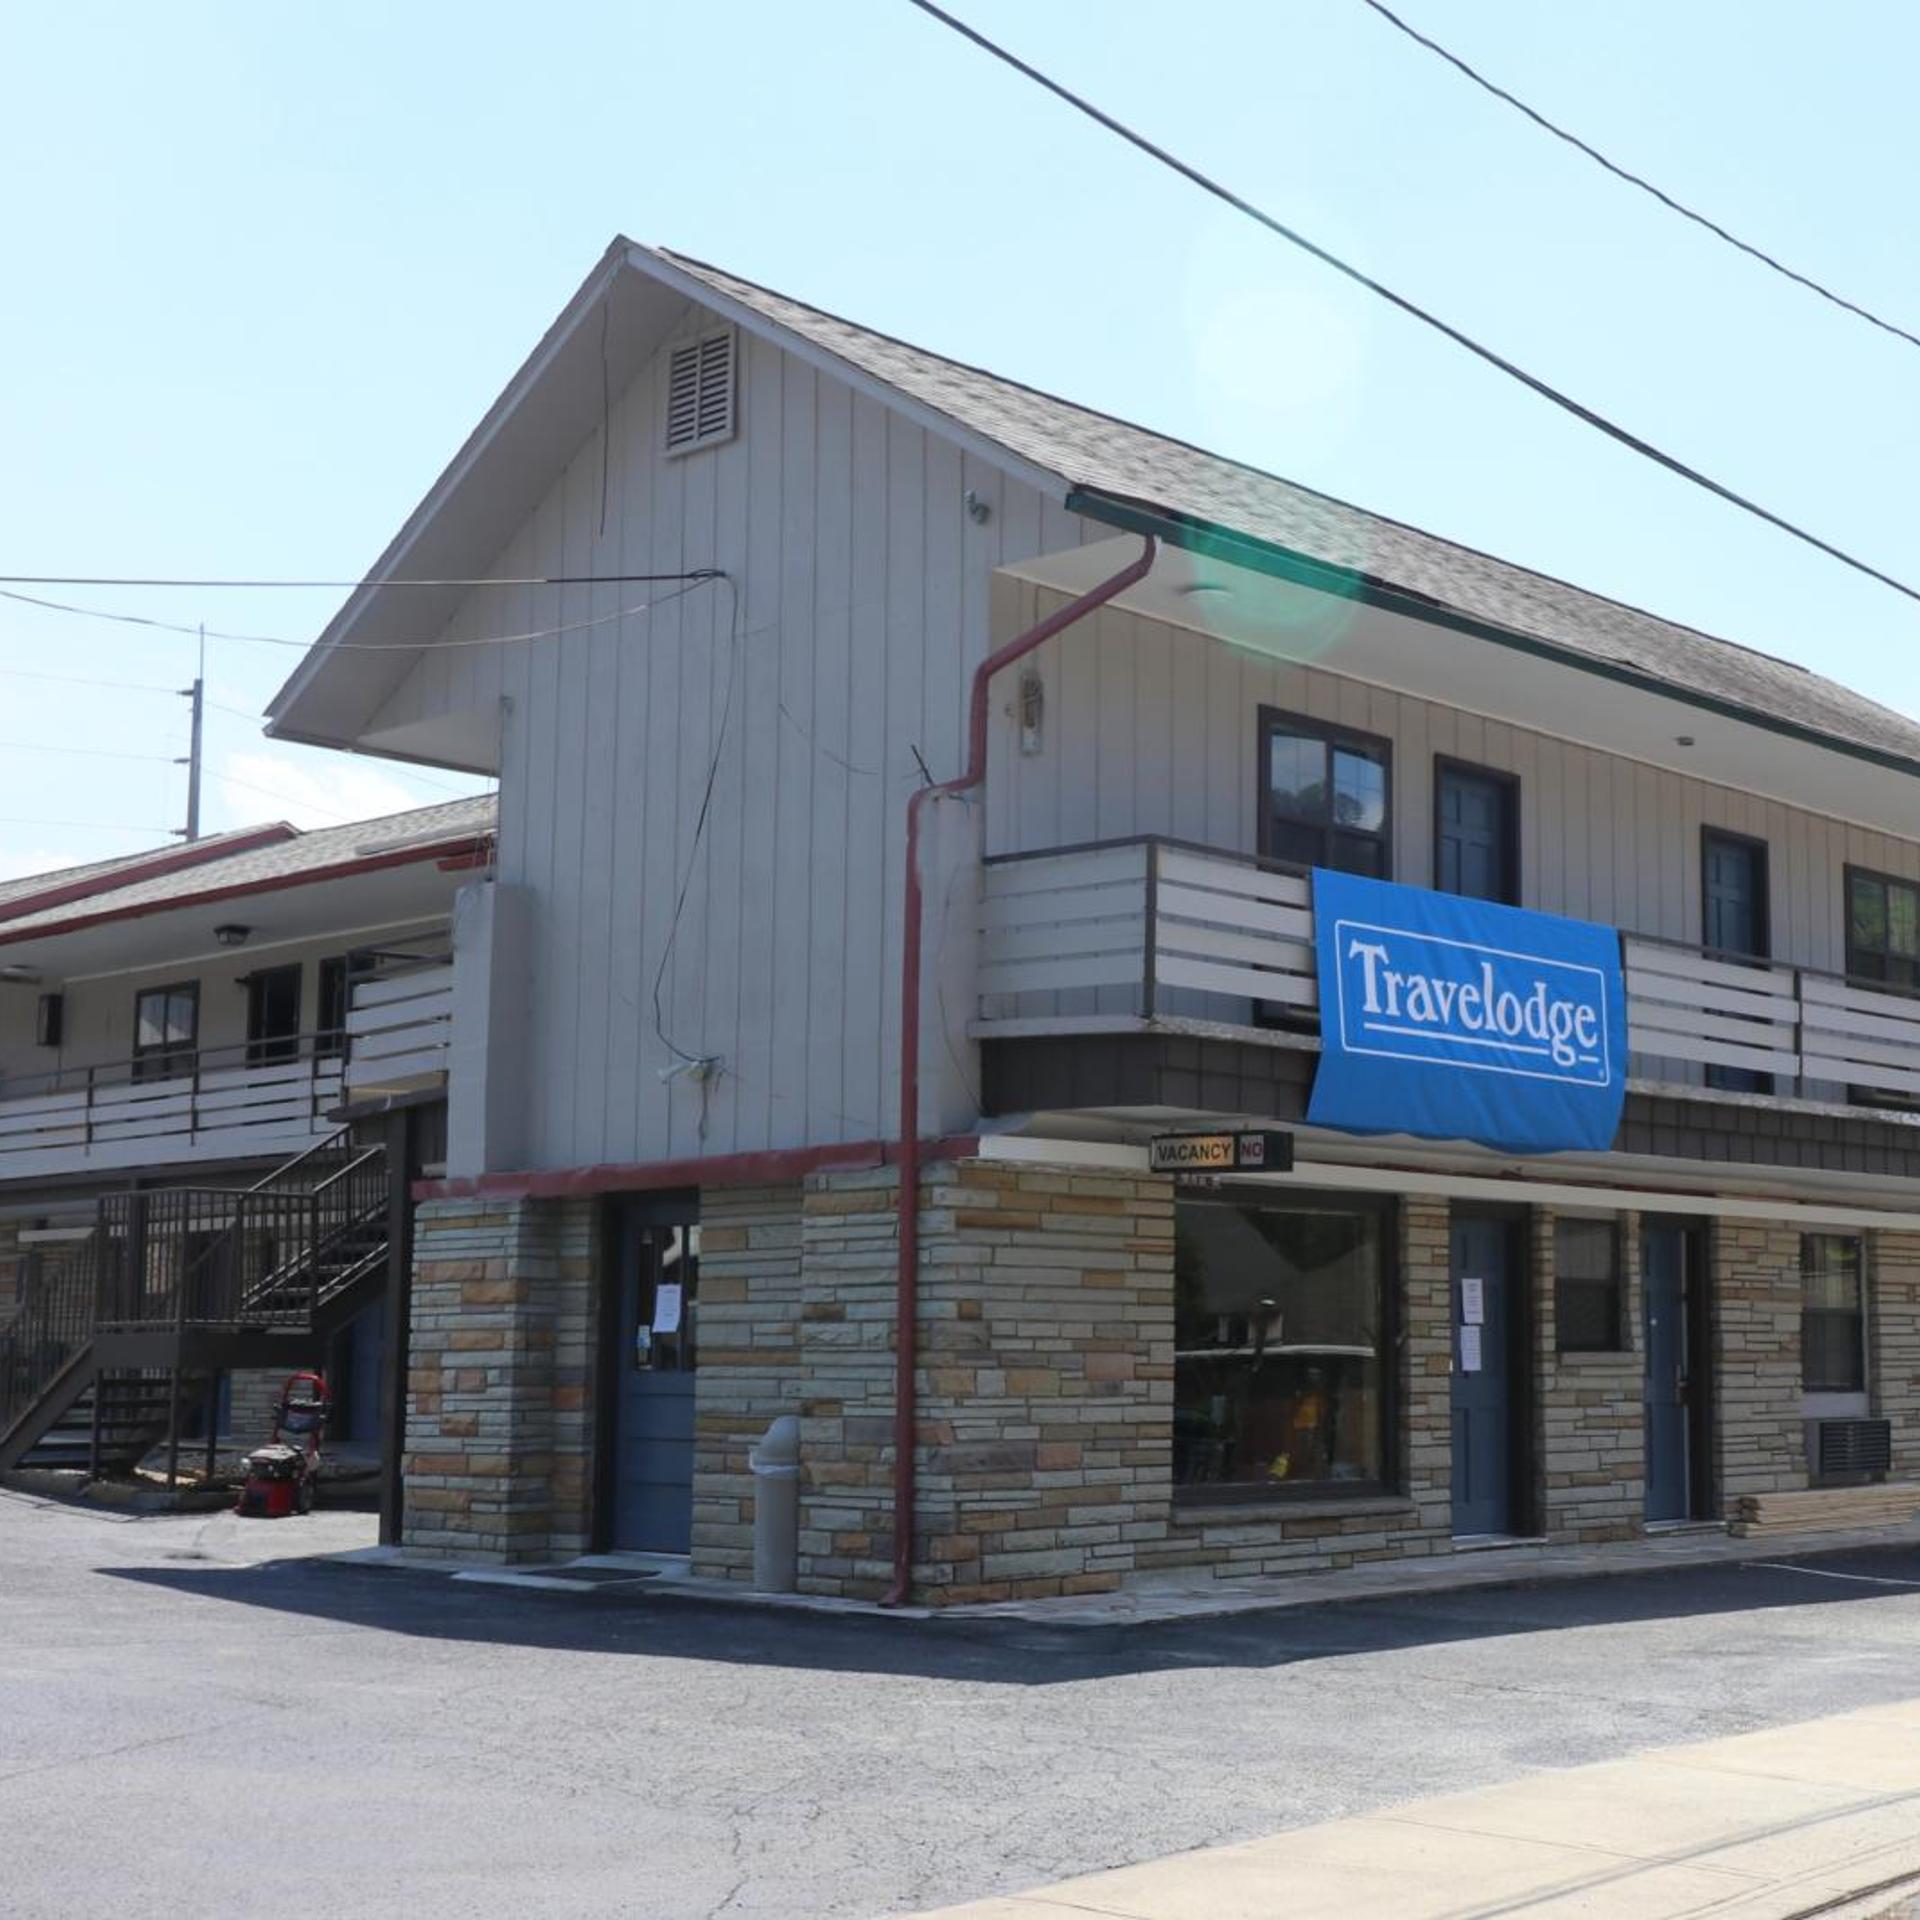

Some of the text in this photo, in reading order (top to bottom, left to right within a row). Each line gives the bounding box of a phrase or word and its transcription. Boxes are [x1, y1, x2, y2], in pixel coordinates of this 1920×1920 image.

[1349, 940, 1598, 1066] Travelodge
[1157, 1142, 1263, 1161] VACANCY NO
